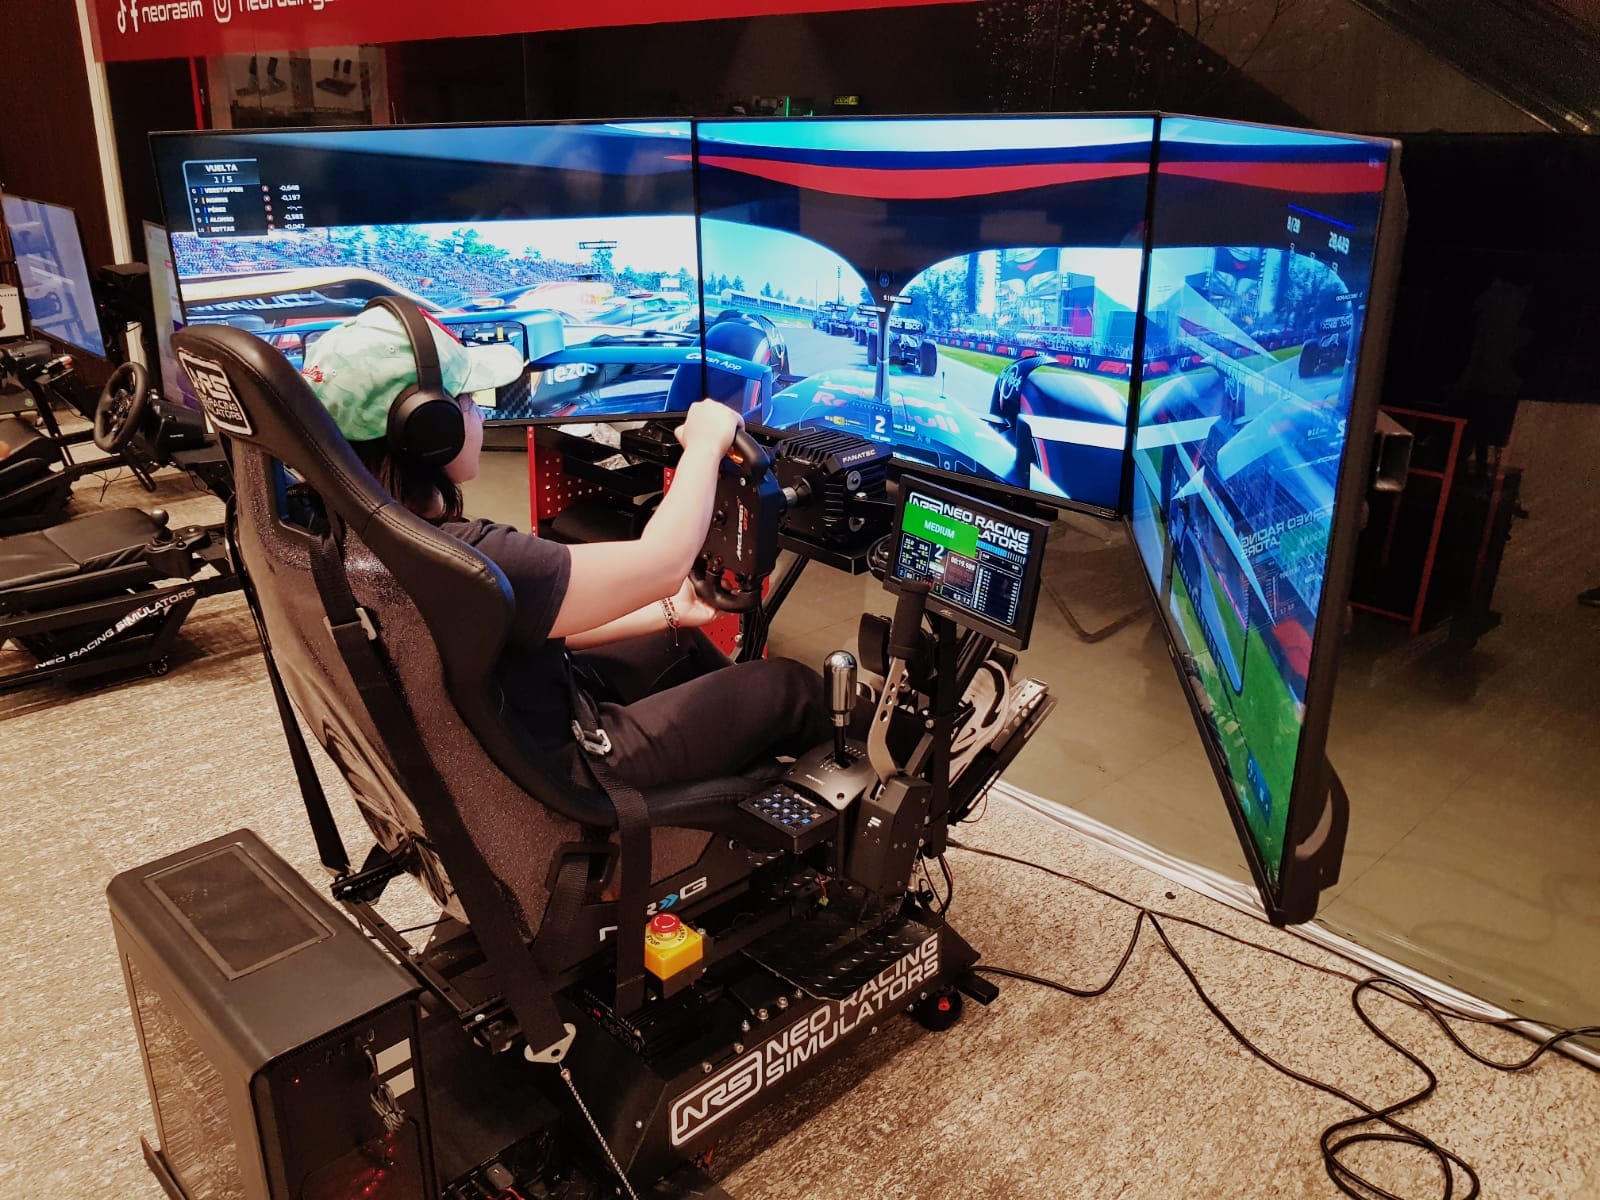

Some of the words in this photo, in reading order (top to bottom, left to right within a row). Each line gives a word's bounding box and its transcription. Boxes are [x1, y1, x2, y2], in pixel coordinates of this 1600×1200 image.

[205, 164, 238, 172] VUELTA
[875, 415, 886, 433] 2
[842, 448, 877, 463] FANATEC
[924, 520, 956, 539] MEDIUM
[943, 503, 973, 523] NEO
[975, 515, 1030, 544] RACING
[934, 543, 945, 559] 2
[35, 656, 66, 669] NEO
[69, 628, 114, 659] RACING
[115, 587, 196, 633] SIMULATORS
[766, 1004, 831, 1064] NEO
[839, 932, 938, 1014] RACING
[766, 953, 939, 1087] SIMULATORS
